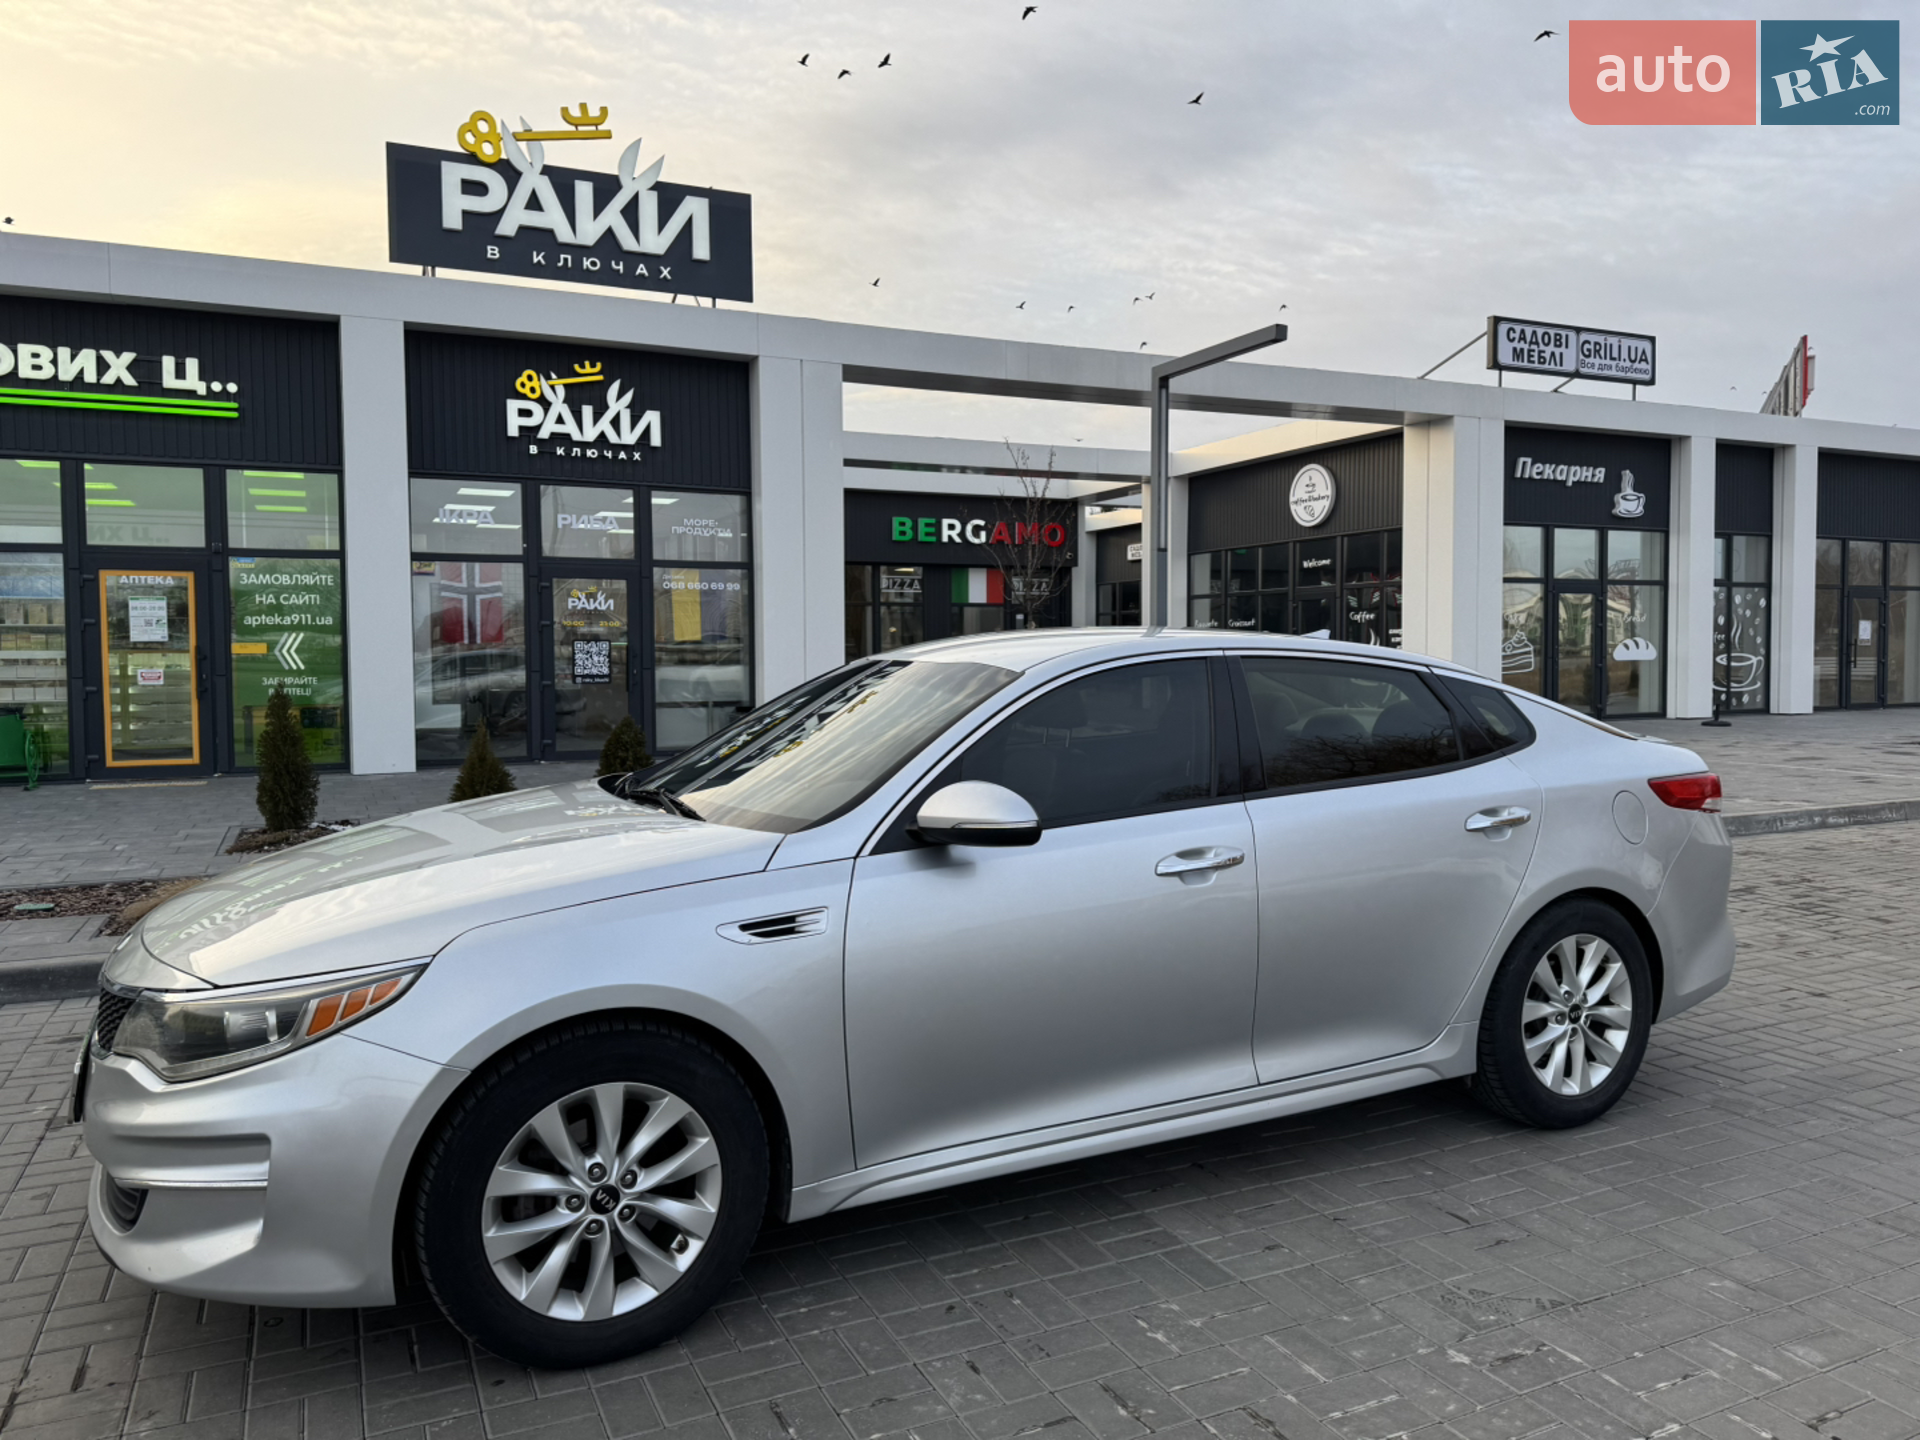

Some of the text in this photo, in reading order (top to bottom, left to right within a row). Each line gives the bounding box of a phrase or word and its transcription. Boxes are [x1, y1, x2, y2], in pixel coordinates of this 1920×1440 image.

[441, 160, 711, 261] РАКИ
[486, 245, 672, 280] В КЛЮЧАХ
[1506, 326, 1569, 349] САДОВІ
[1511, 347, 1564, 368] МЕБЛІ
[1580, 358, 1650, 376] Все для барбекю
[506, 398, 662, 447] РАКИ
[529, 445, 642, 461] В КЛЮЧАХ
[1514, 456, 1606, 487] Пекарня
[557, 513, 620, 530] РИБА
[891, 516, 1065, 548] BERGAMO
[119, 575, 175, 585] АПТЕКА
[240, 571, 335, 586] ЗАМОВЛЯЙТЕ
[881, 578, 921, 590] PIZZA
[1013, 580, 1049, 592] PIZA
[255, 592, 320, 605] НА САЙТІ
[567, 597, 615, 611] РАКИ
[243, 613, 334, 628] apteka911.ua
[1348, 610, 1376, 624] Coffee
[278, 687, 312, 697] ПТЕЦІ
[595, 1189, 617, 1211] KIA
